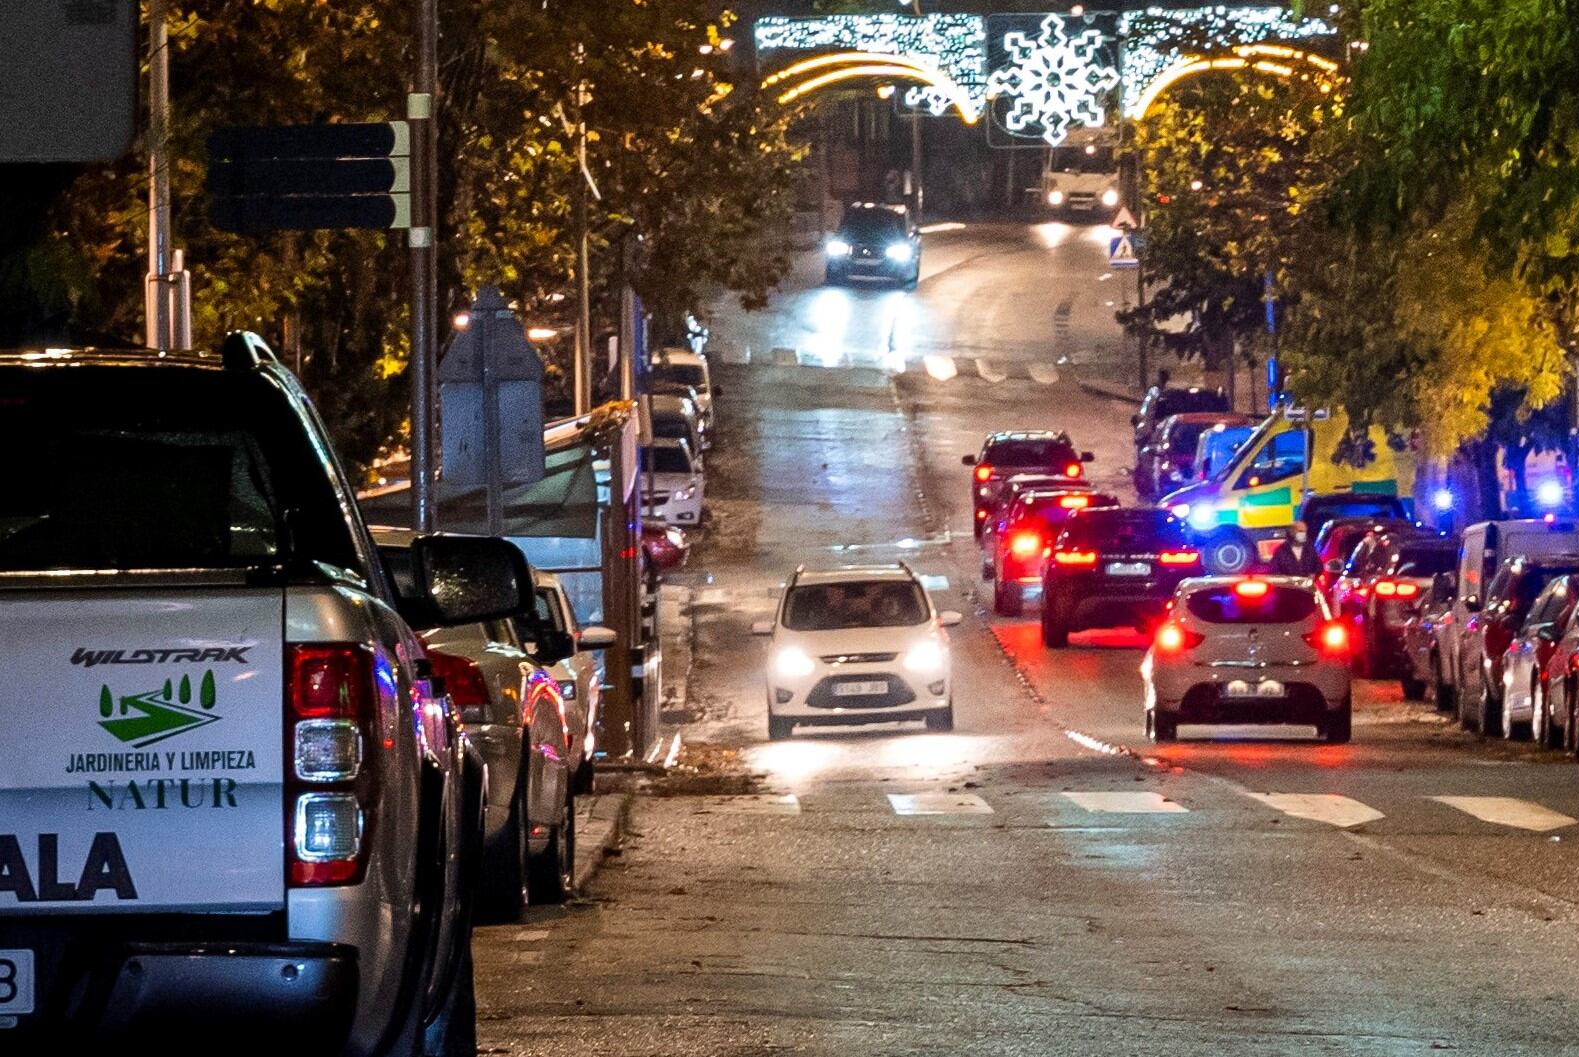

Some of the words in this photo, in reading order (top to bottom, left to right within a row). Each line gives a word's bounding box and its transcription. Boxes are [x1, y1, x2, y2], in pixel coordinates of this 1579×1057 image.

[70, 647, 251, 668] WILDTRAK
[66, 752, 161, 774] JARDINERIA
[165, 751, 176, 771] Y
[181, 750, 256, 771] LIMPIEZA
[86, 778, 238, 811] NATUR
